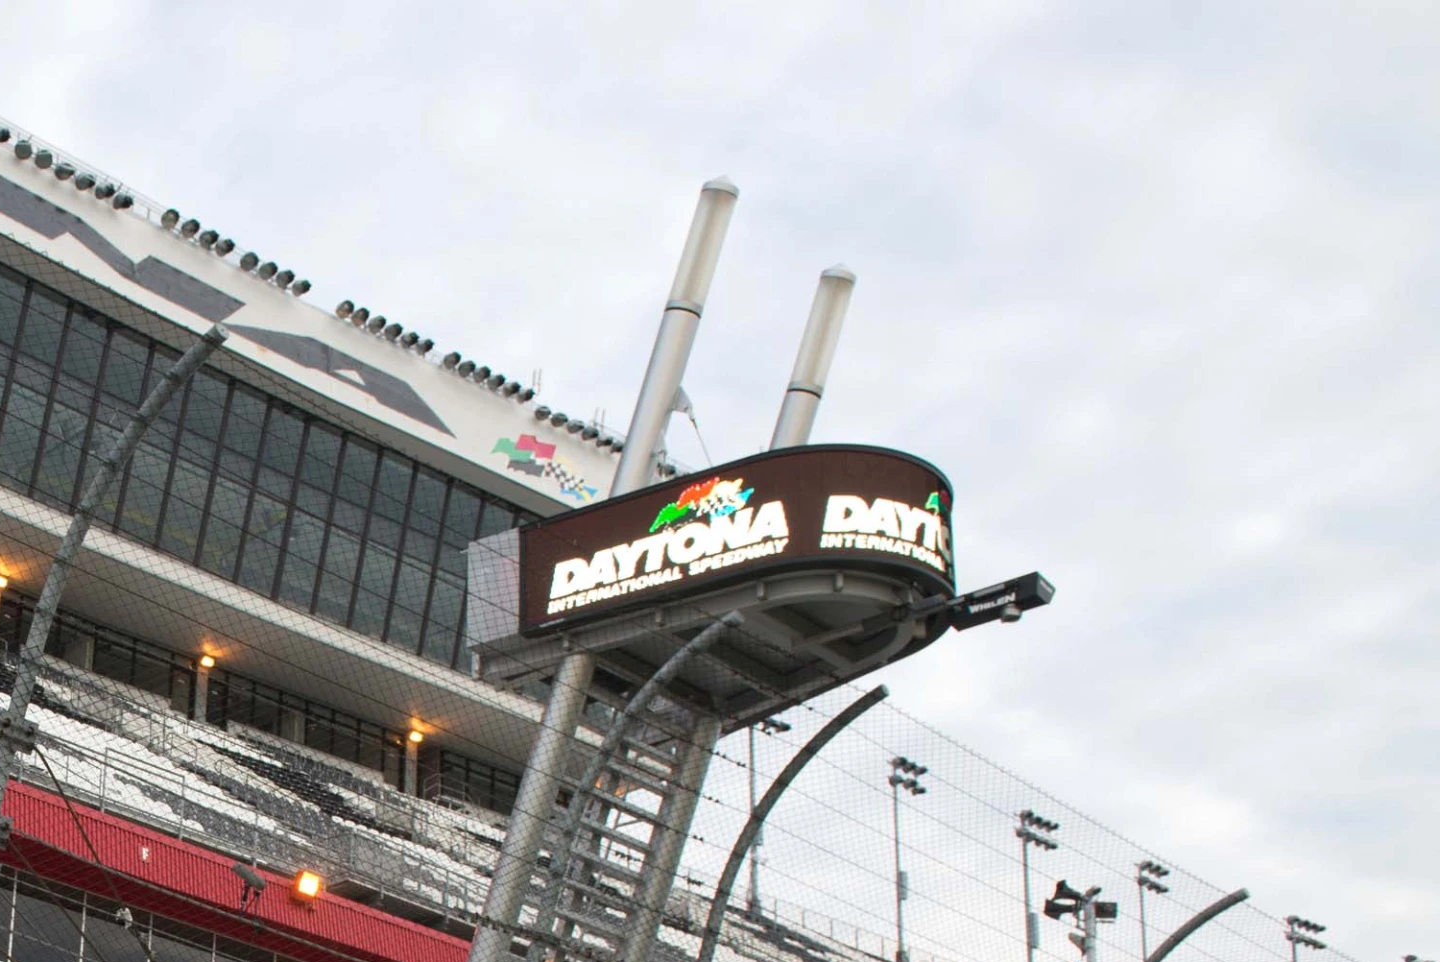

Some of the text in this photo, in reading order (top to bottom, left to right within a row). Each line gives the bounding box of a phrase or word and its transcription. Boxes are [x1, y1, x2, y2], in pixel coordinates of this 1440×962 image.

[547, 538, 789, 615] INTERNATIONAL SPEEDWAY
[551, 500, 789, 599] DAYTONA
[968, 592, 1016, 614] WHELEN
